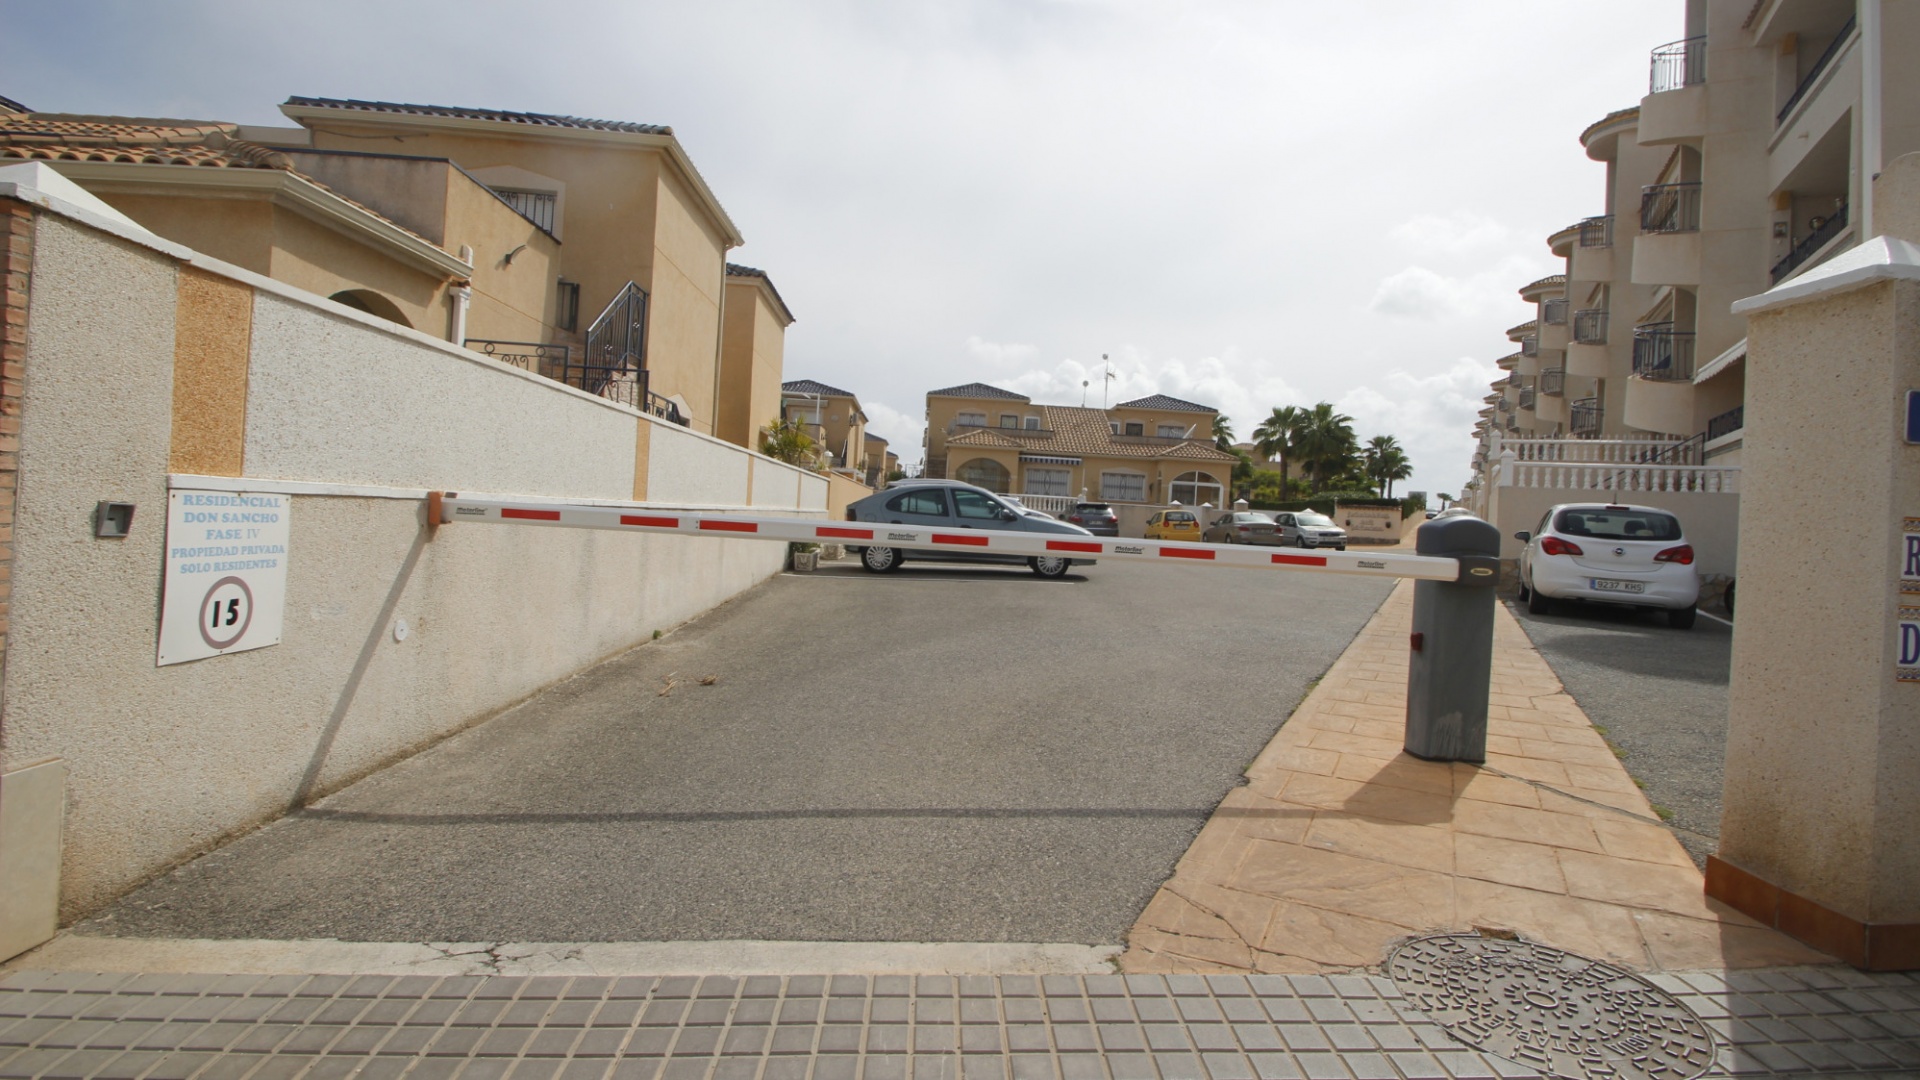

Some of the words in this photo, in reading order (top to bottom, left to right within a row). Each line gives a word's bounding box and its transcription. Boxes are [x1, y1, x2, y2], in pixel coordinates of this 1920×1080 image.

[183, 494, 281, 508] RESIDENCIAL
[183, 512, 218, 523] DON
[222, 512, 279, 524] SANCHO
[205, 529, 242, 540] FASE
[246, 528, 261, 539] IV
[171, 546, 239, 559] PROPIEDAD
[241, 545, 285, 556] PRIVADA
[180, 563, 211, 574] SOLO
[213, 559, 278, 572] RESIDENTES
[1597, 580, 1620, 589] 9237
[1624, 583, 1643, 591] KHS
[212, 598, 240, 628] 15
